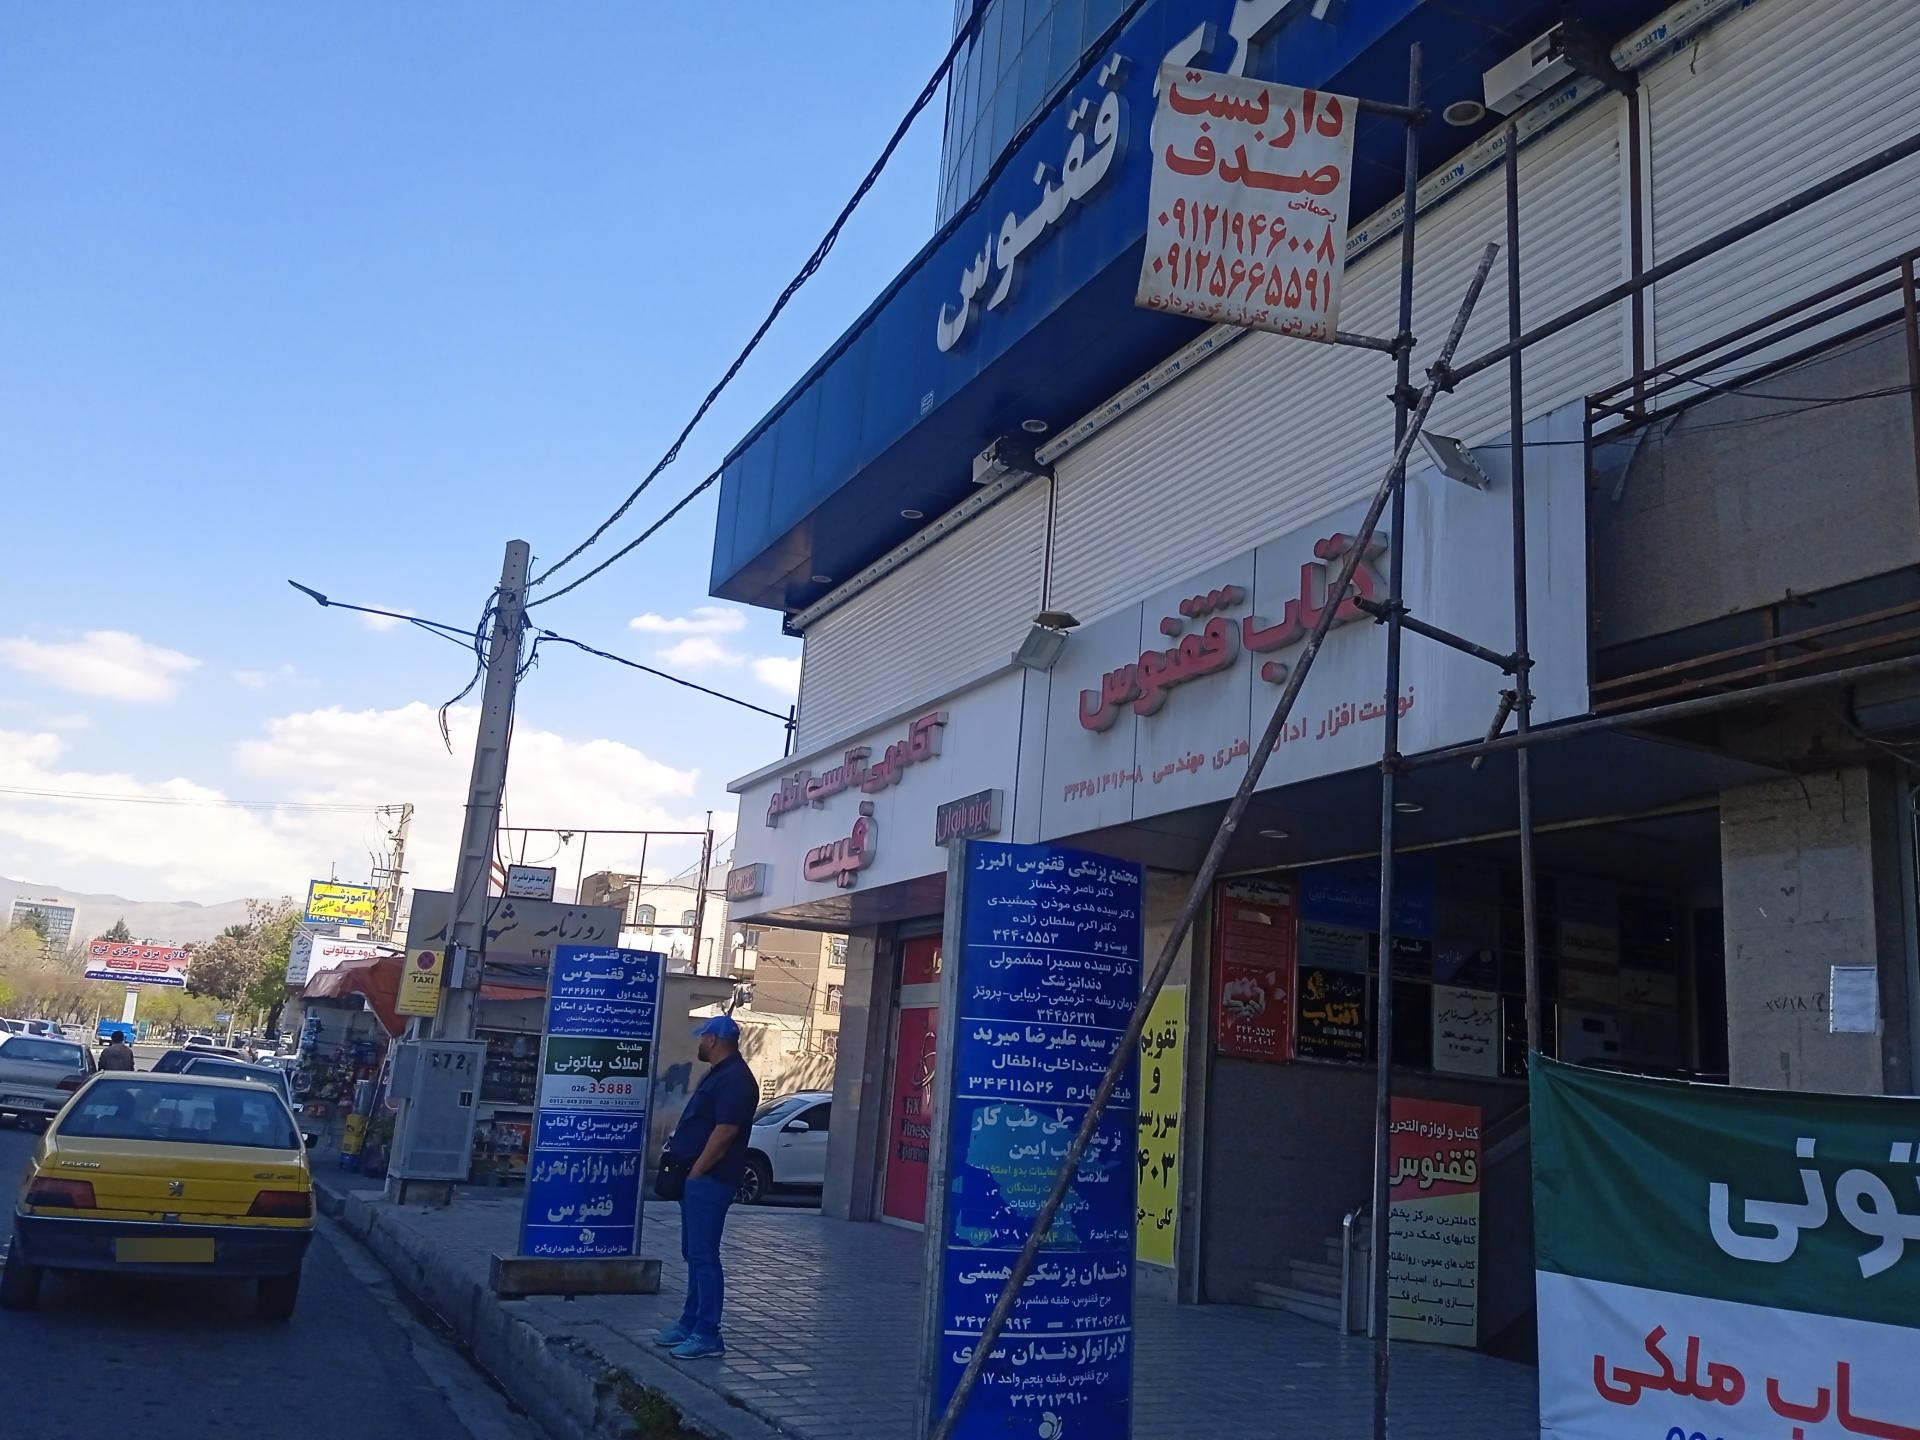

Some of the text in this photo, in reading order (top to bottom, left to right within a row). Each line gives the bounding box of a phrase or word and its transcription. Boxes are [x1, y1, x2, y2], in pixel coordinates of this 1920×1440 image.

[1165, 122, 1341, 196] صدف
[937, 54, 1130, 352] ققنوس
[1287, 197, 1338, 223] رحمانی
[1157, 197, 1336, 267] ۰۹۱۲۱۹۴۶۰۰۸
[1152, 242, 1331, 313] ۰۹۱۲۵۶۶۵۵۹۱
[1078, 584, 1246, 733] ققنوس
[1269, 717, 1307, 753] ادار
[1152, 751, 1206, 785] مهندسی
[976, 852, 1012, 871] البرز
[1016, 856, 1065, 875] ققنوس
[1068, 860, 1107, 884] پزشکی
[313, 889, 368, 904] آموزشی
[987, 895, 1038, 908] جمشیدی
[535, 911, 606, 940] روزنامه
[1013, 913, 1037, 925] زاده
[1040, 915, 1075, 928] سلطان
[992, 929, 1059, 945] ۳۴۴۰۵۵۵۳
[92, 944, 188, 962] کالای برق مرکزی کرج
[322, 945, 356, 958] بیاتونی
[573, 948, 649, 965] برج ققنوس
[989, 952, 1043, 971] مشمولی
[1046, 954, 1081, 971] سمیرا
[412, 976, 435, 984] TAXI
[561, 967, 655, 986] دفتر ققنوس
[560, 986, 606, 996] ۳۴۴۶۶۱۲۷
[1037, 1009, 1096, 1025] ۳۴۴۵۶۳۲۹
[1025, 1026, 1077, 1050] علیرضا
[554, 1055, 643, 1072] املاک بیاتونی
[969, 1076, 1097, 1100] هارم ۳۴۴۱۱۵۲۶
[1150, 1066, 1161, 1094] و
[546, 1116, 577, 1130] آفتاب
[577, 1117, 610, 1131] سرای
[1389, 1120, 1419, 1135] التحری
[1420, 1121, 1446, 1138] لوازم
[1454, 1127, 1479, 1144] کتاب
[532, 1156, 568, 1182] تحریر
[1138, 1148, 1176, 1189] ۴۰۳
[1389, 1149, 1479, 1189] ققنوس
[1413, 1210, 1434, 1222] مرکز
[1417, 1229, 1442, 1241] کمک
[958, 1264, 1013, 1285] هستی
[1593, 1324, 1746, 1406] ملکی
[982, 1372, 995, 1385] ۱۷
[997, 1373, 1020, 1386] واحد
[1009, 1391, 1089, 1408] ۳۴۲۱۳۹۱۰
